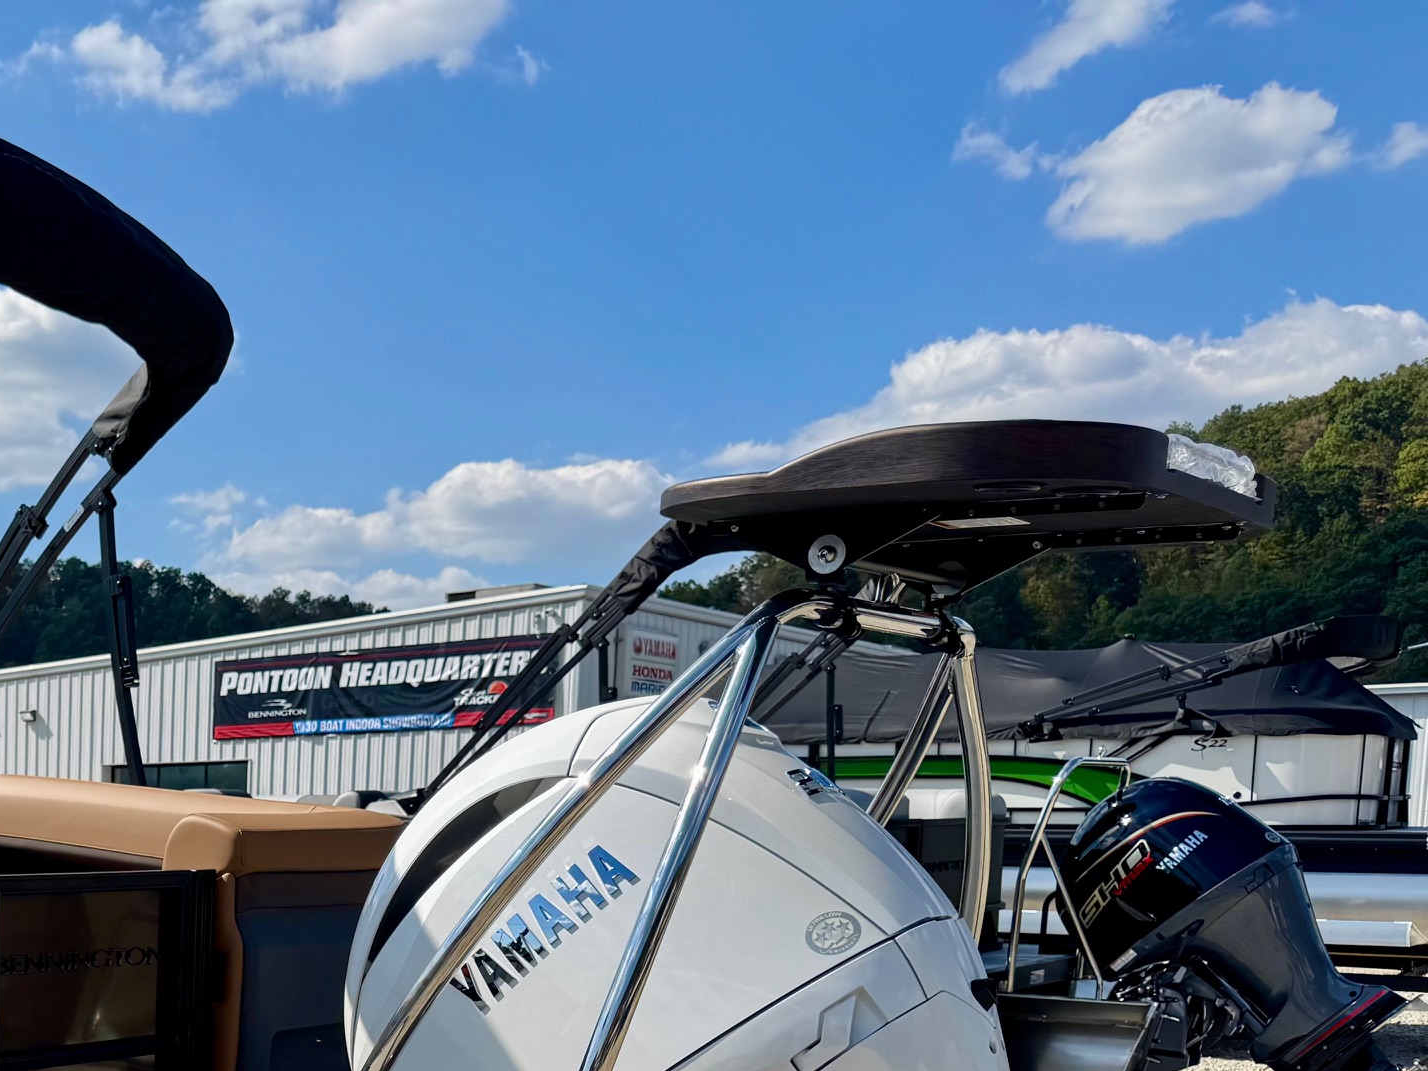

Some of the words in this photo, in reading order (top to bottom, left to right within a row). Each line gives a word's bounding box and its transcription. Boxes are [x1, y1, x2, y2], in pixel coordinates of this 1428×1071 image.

[643, 638, 677, 660] YAMAHA
[220, 665, 333, 696] PONTOON
[632, 665, 673, 681] HONDA
[454, 693, 501, 706] TRACK
[248, 708, 307, 718] BENNINGTON
[320, 719, 344, 732] BOAT
[346, 717, 381, 730] INDOOR
[1155, 829, 1209, 873] YAMAHA
[1079, 838, 1151, 929] SHO
[449, 845, 639, 1015] YAMAHA
